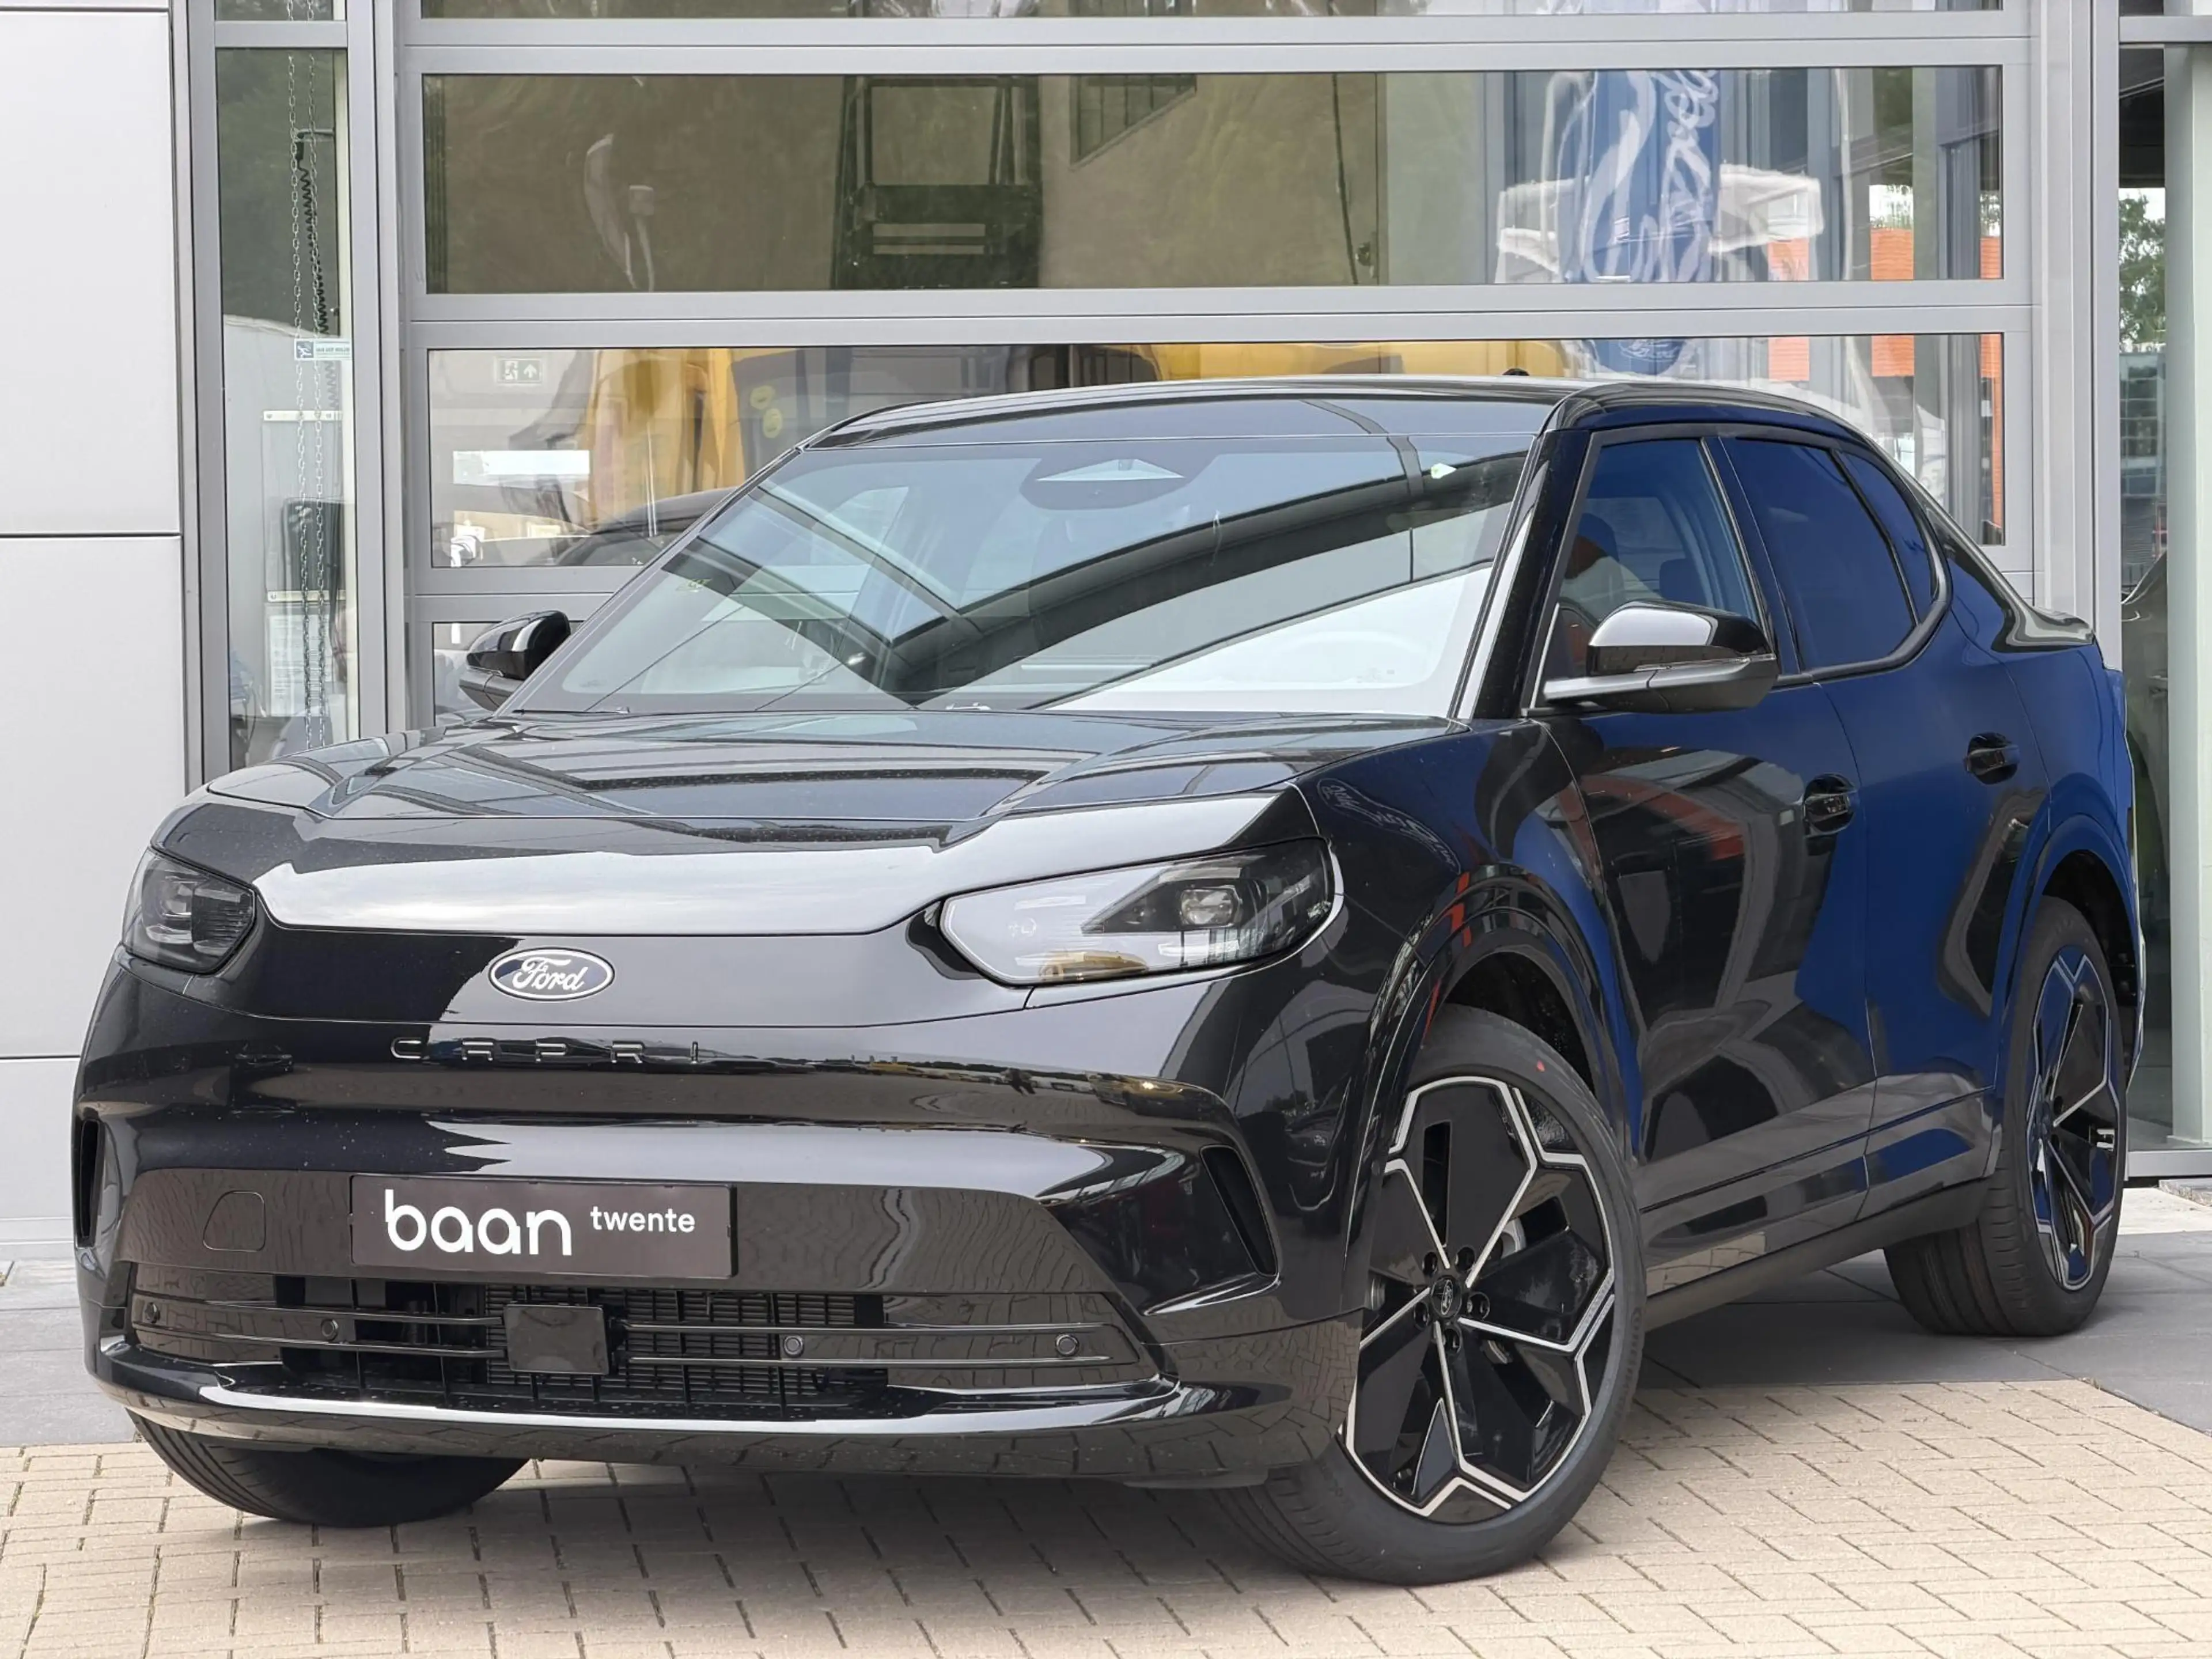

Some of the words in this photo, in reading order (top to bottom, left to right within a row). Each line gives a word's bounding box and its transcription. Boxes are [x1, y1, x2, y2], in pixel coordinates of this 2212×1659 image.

[512, 956, 588, 990] Ford
[390, 1040, 698, 1065] CAPRI
[385, 1189, 571, 1255] baan
[590, 1206, 695, 1233] twente
